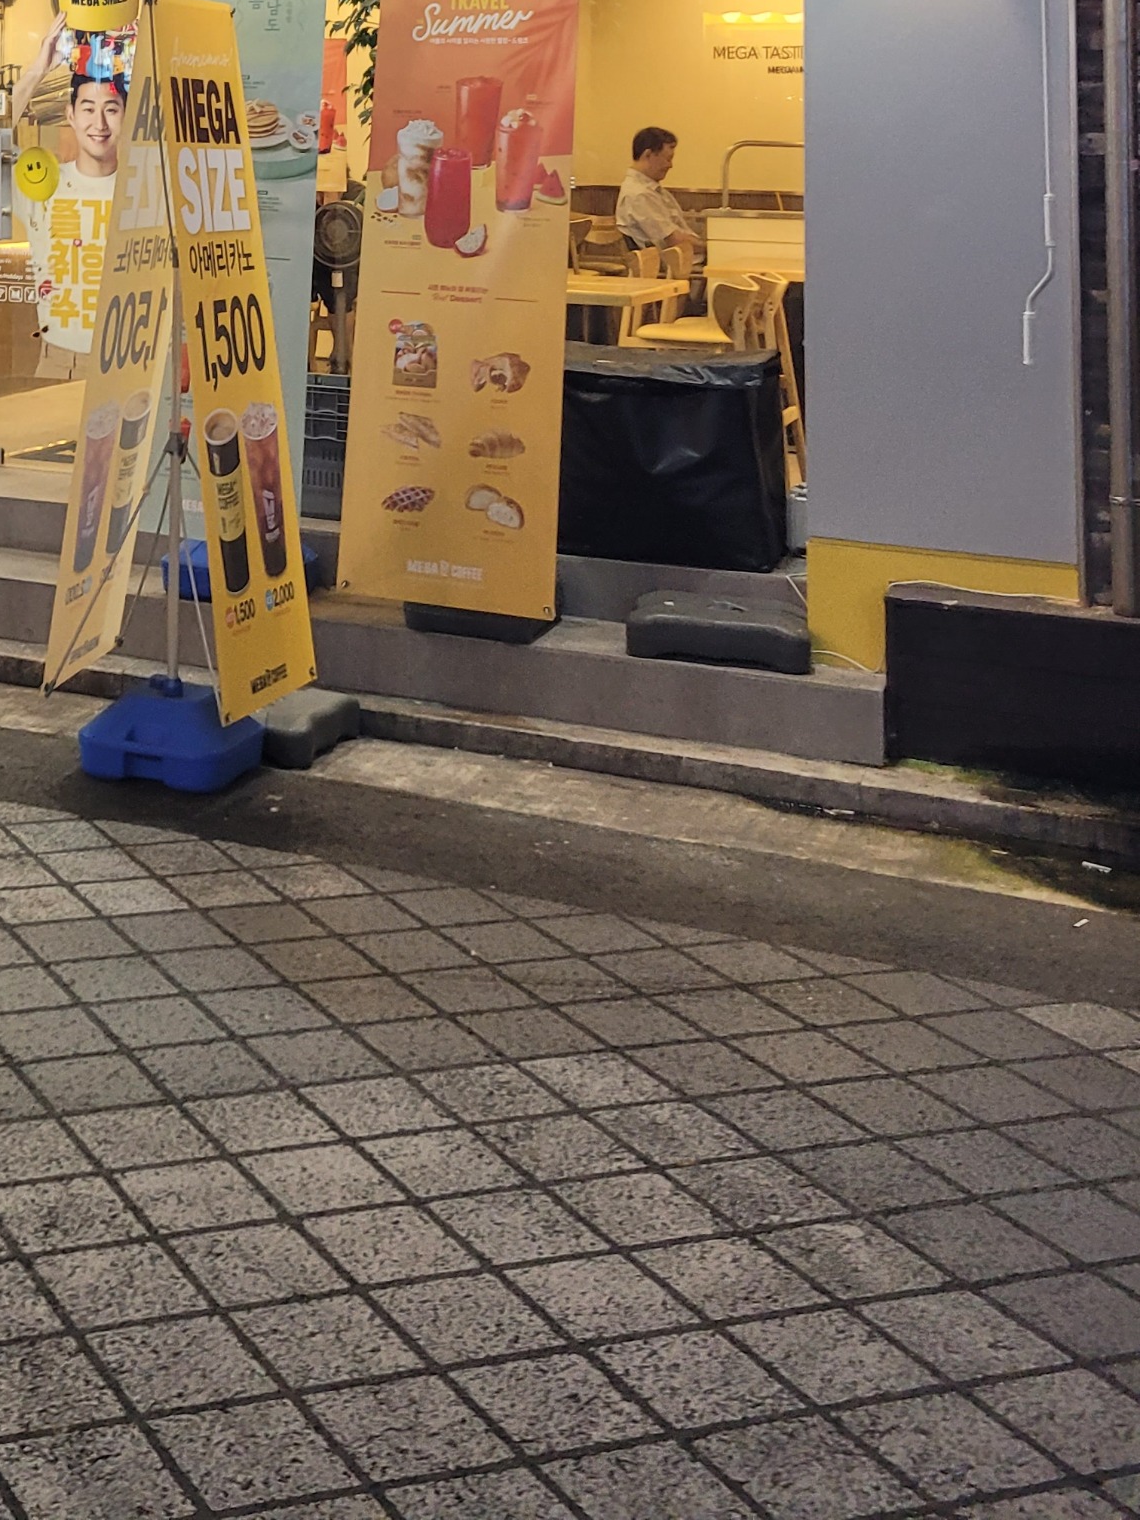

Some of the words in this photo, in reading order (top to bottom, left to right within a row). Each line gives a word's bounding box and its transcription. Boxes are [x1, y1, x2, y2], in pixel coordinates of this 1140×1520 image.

[412, 2, 534, 42] Summer
[713, 46, 758, 60] MEGA
[170, 76, 241, 145] MEGA
[177, 147, 252, 236] SIZE
[50, 199, 112, 240] 즐거
[47, 240, 103, 285] 취향
[189, 239, 255, 280] 아메리카노
[195, 292, 267, 392] 1,500
[233, 597, 256, 626] 1,500
[273, 580, 295, 608] 2,000
